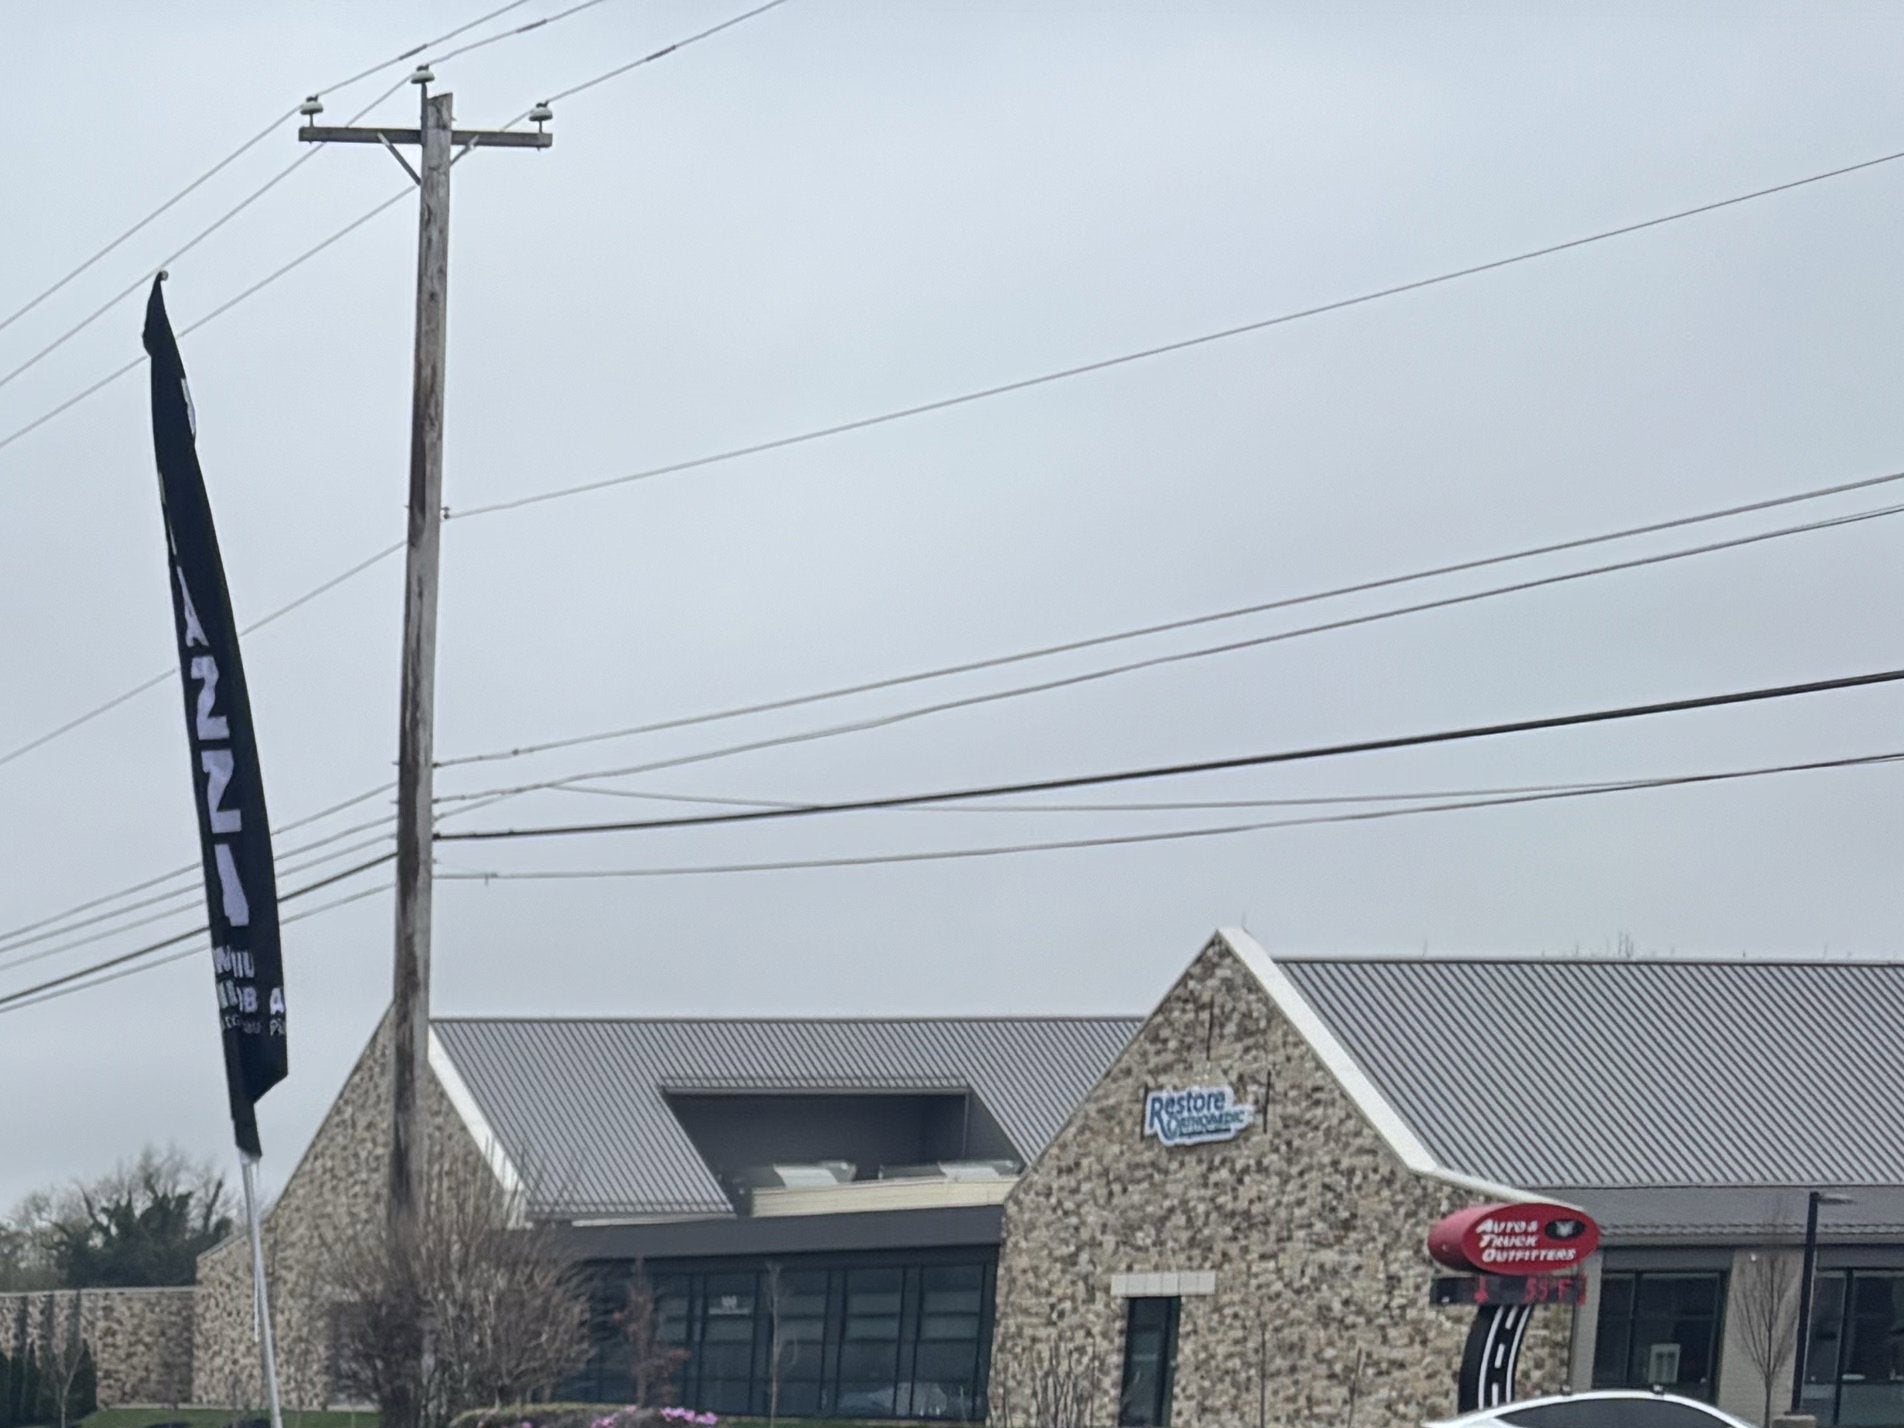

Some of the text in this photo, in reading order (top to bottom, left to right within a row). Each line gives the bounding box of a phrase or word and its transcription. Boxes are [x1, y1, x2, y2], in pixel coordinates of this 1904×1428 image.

[1149, 1091, 1226, 1140] Restore
[1475, 1219, 1527, 1234] AUTO
[1479, 1234, 1539, 1248] TRUCK
[1482, 1248, 1576, 1263] OUTFITTERS
